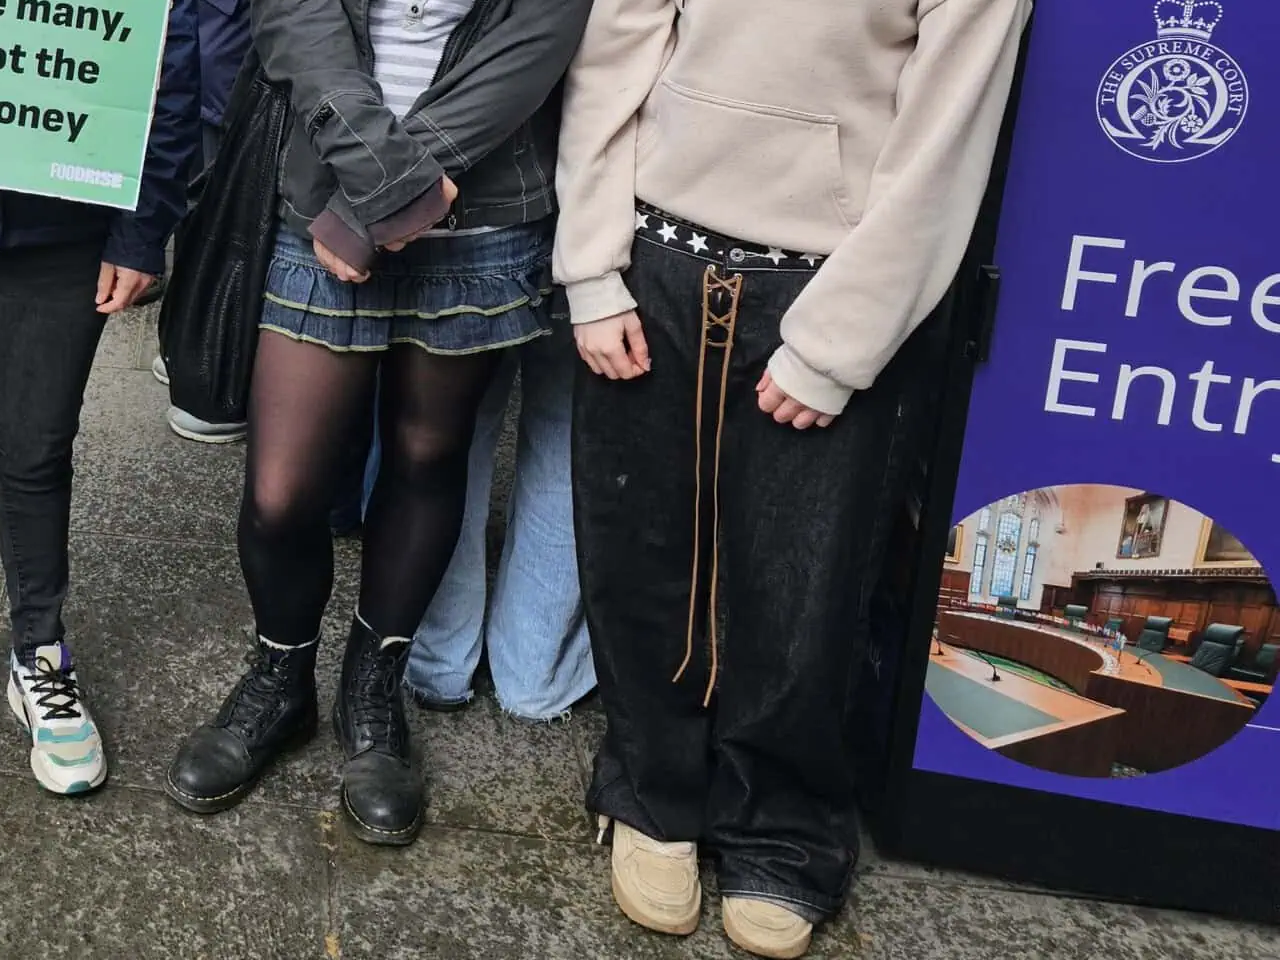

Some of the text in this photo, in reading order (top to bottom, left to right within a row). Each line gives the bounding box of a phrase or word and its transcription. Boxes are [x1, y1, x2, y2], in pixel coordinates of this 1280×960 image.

[35, 48, 101, 84] the
[1101, 41, 1244, 115] THE SUPREME COURT
[50, 162, 123, 189] FOODRISE
[1044, 338, 1280, 463] Entr
